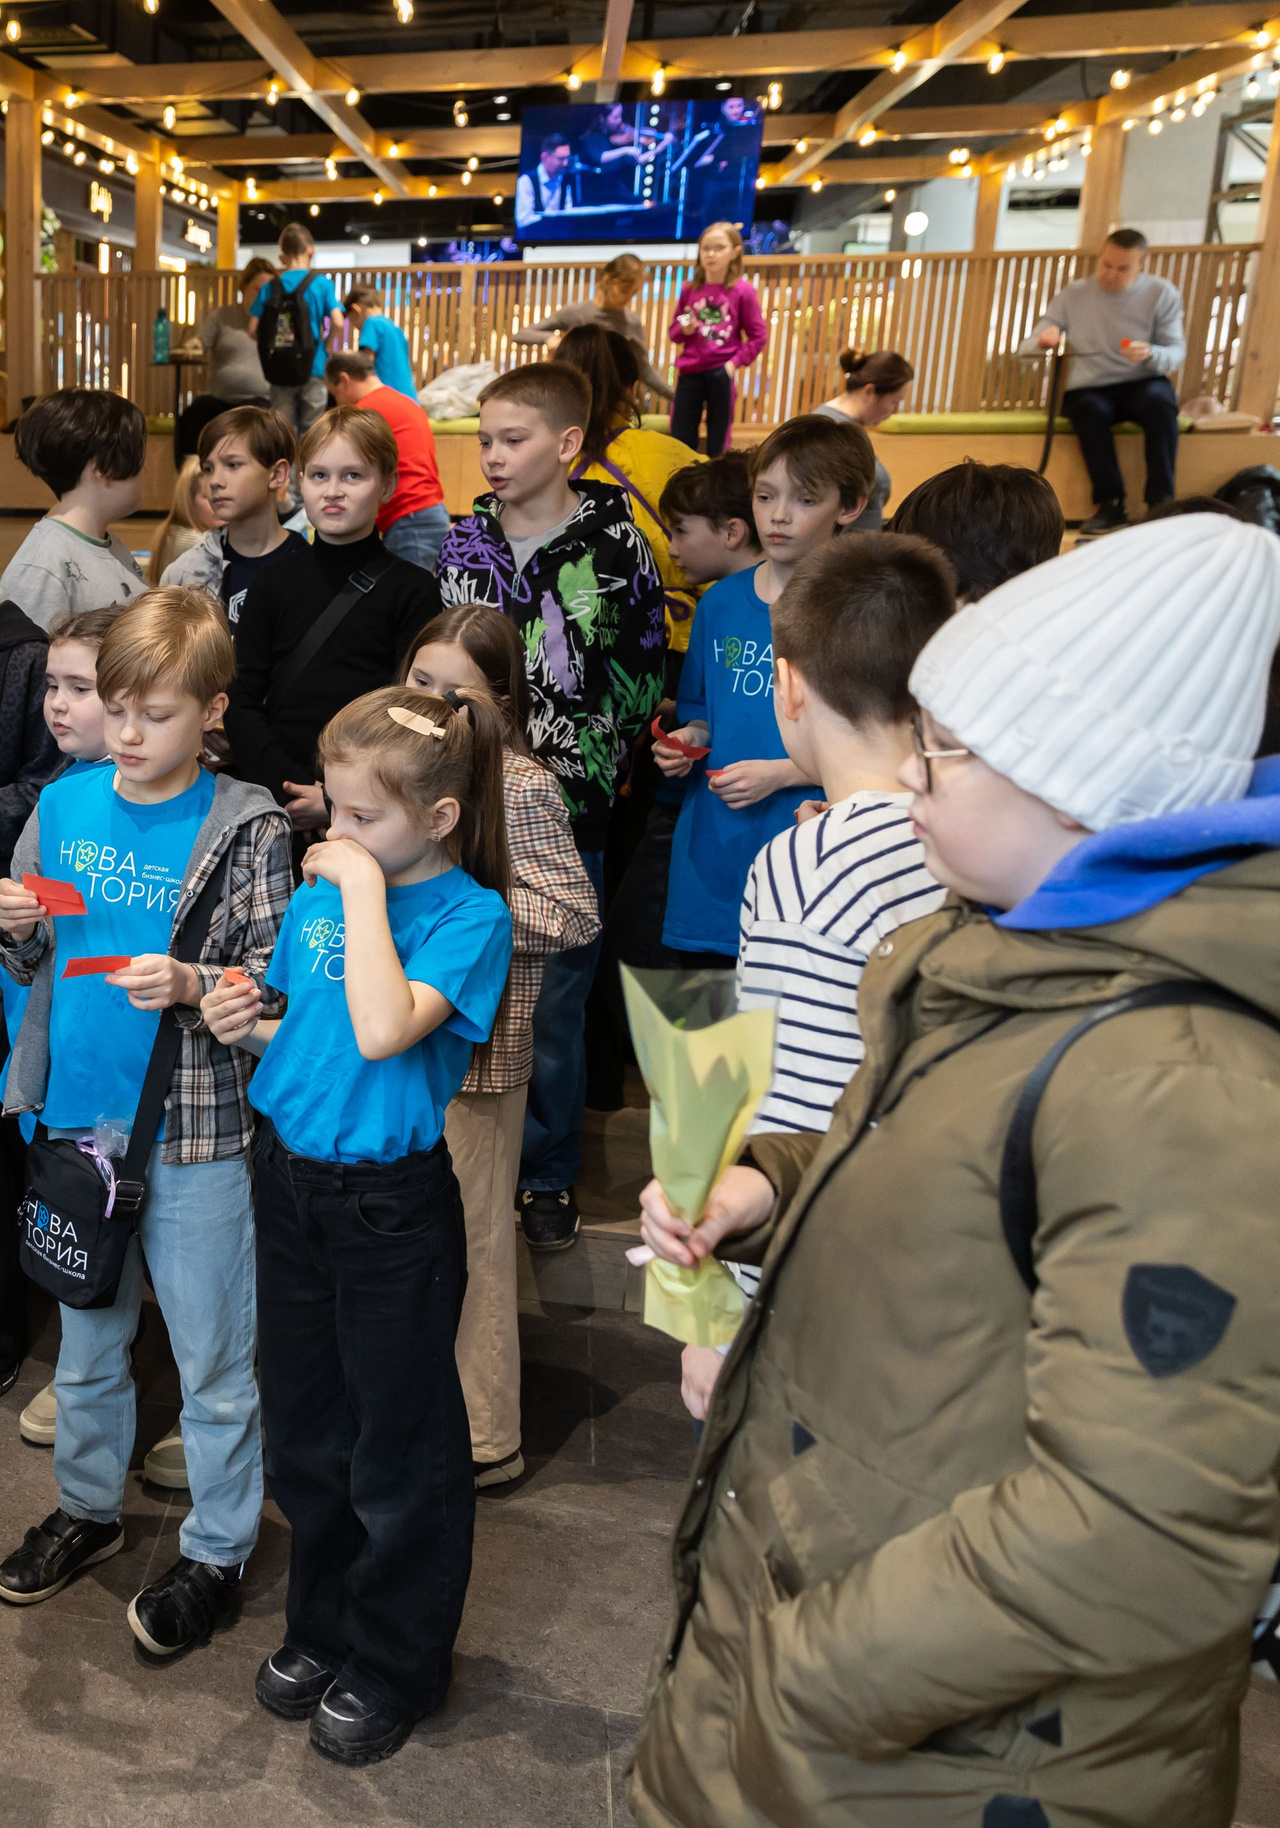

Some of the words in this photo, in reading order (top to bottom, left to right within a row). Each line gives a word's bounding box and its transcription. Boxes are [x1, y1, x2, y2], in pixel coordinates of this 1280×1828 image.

[60, 839, 136, 877] НОВА
[141, 872, 183, 885] бизнес-школ
[300, 919, 345, 948] НОВ
[26, 1218, 88, 1271] ТОРИЯ
